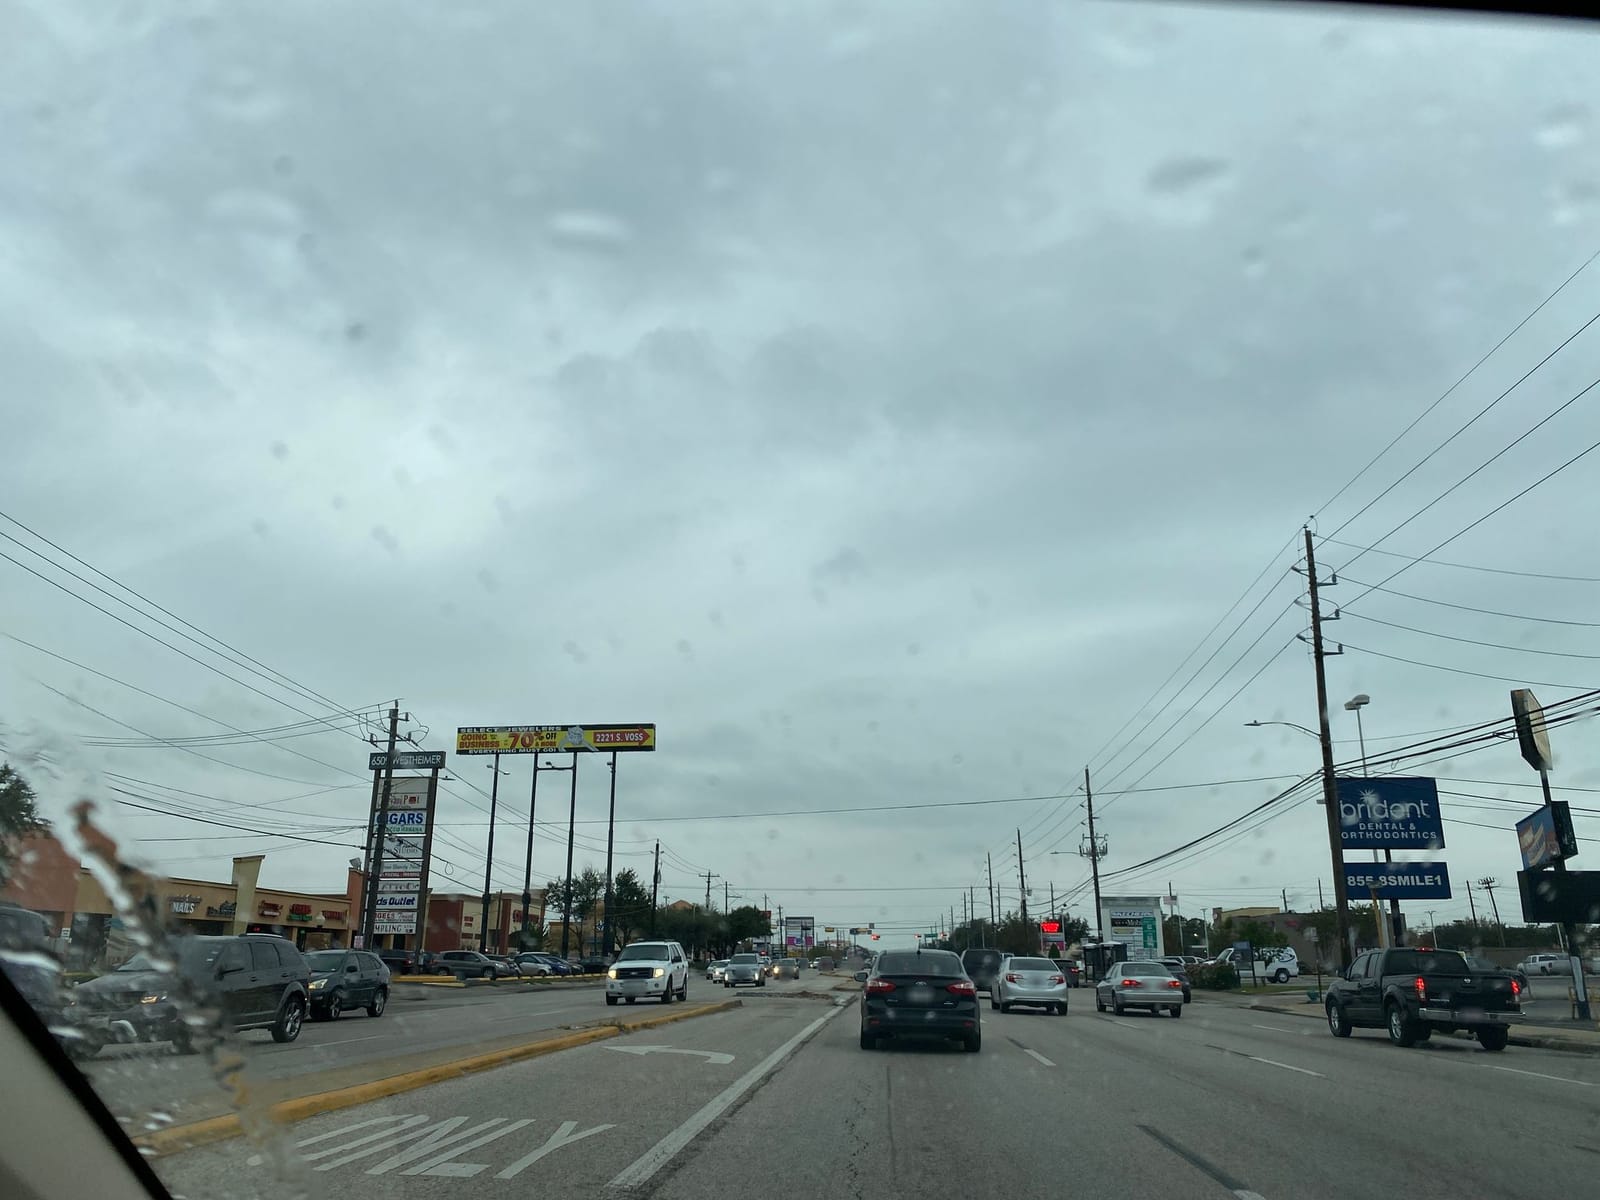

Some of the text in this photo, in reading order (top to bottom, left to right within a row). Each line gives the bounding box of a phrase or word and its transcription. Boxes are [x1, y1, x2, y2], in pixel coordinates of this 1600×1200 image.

[461, 733, 488, 741] GOING
[545, 732, 557, 740] OFF
[596, 733, 614, 742] 2221
[625, 733, 644, 741] VOSS
[459, 741, 500, 749] BUSINESS
[392, 754, 442, 765] WESTHEIMER
[1339, 796, 1431, 819] brident
[1359, 822, 1417, 831] DENTAL &
[1341, 831, 1438, 840] ORTHODONTICS
[388, 896, 416, 906] Outlet
[173, 902, 195, 914] NAILS
